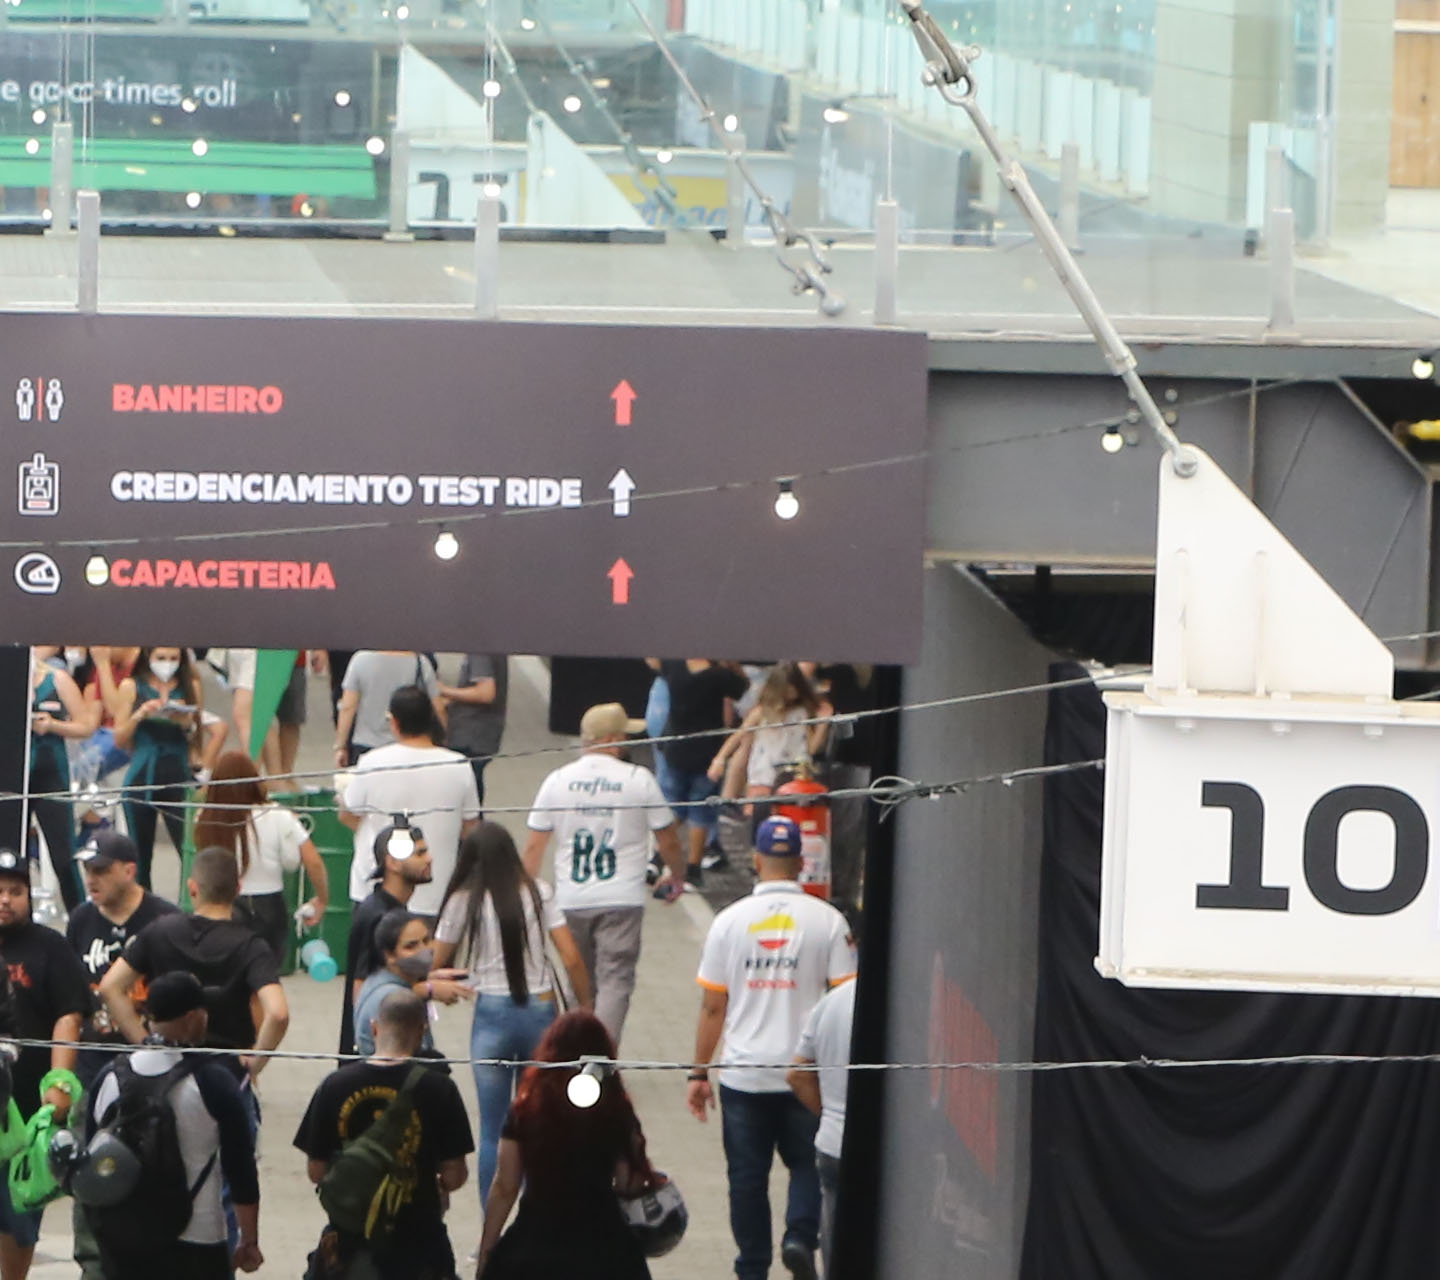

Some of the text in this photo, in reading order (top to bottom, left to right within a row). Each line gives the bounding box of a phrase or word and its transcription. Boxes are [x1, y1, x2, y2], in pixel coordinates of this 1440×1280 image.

[104, 76, 182, 106] times
[111, 384, 283, 414] BANHEIRO
[111, 471, 582, 508] CREDENCIAMENTO TEST RIDE
[110, 558, 336, 590] CAPACETERIA
[1196, 780, 1431, 917] 10
